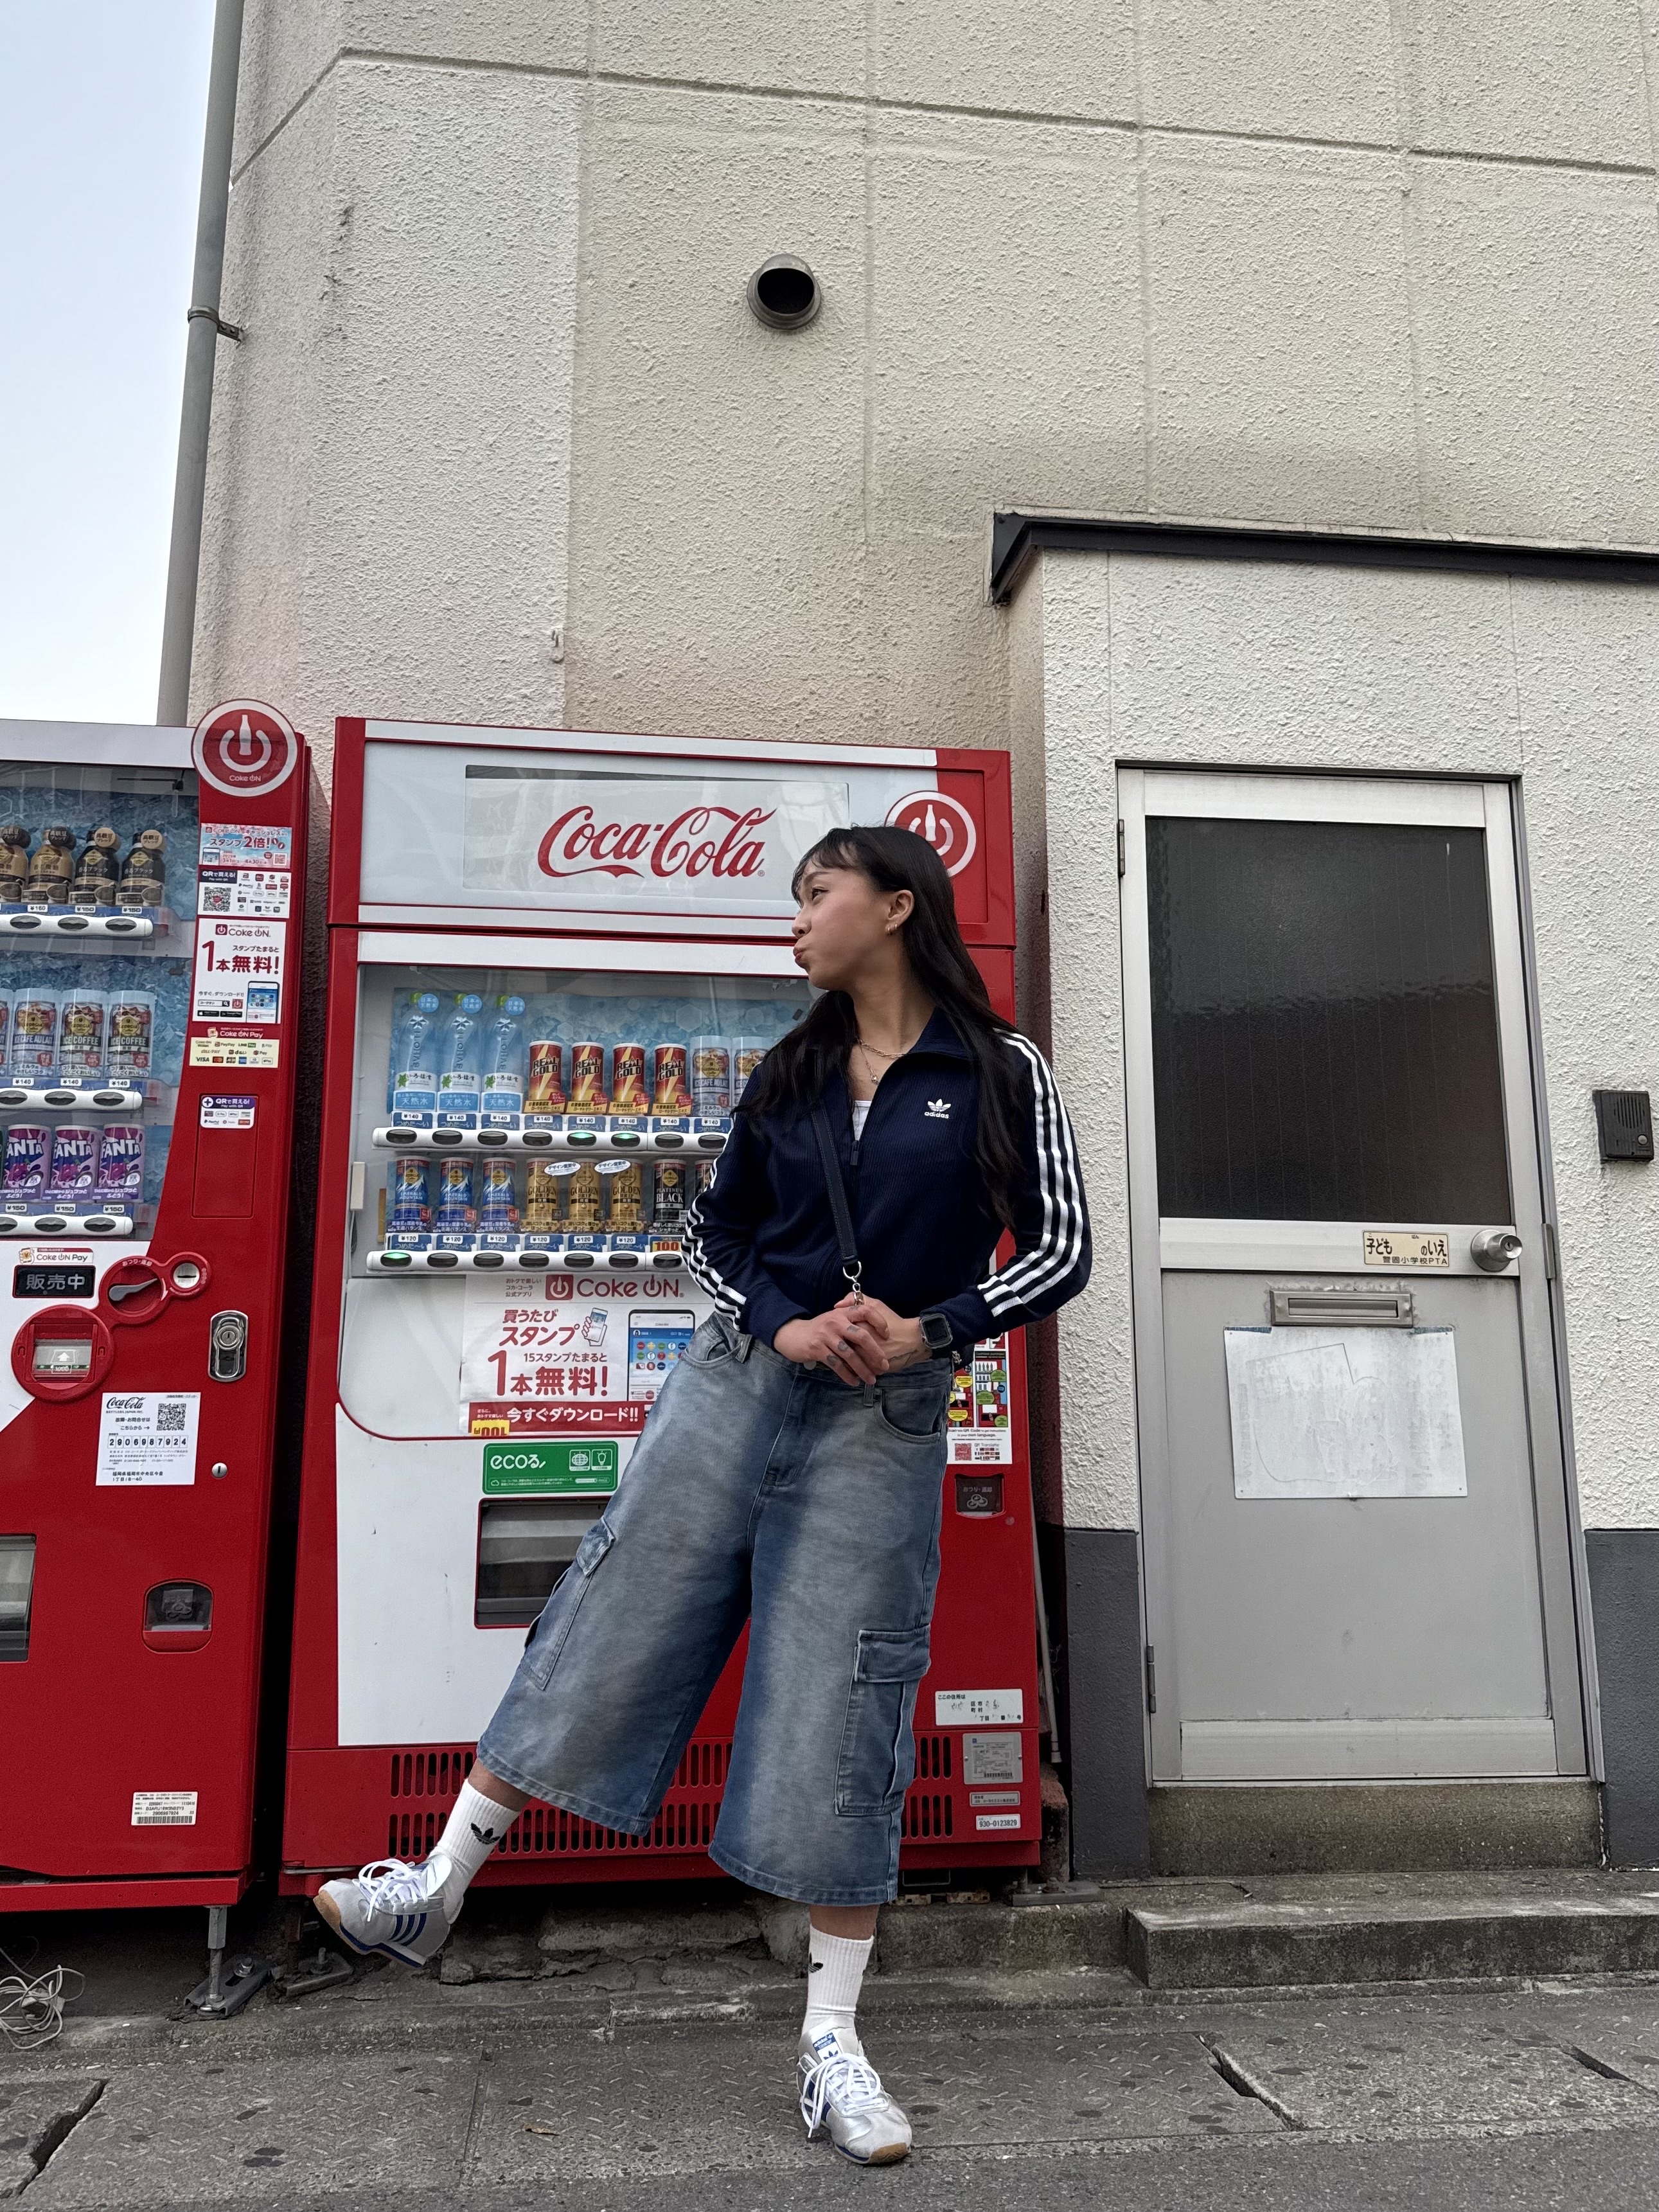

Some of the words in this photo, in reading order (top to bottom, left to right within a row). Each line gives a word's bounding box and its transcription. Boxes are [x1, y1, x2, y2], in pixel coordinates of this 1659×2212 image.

[538, 805, 777, 879] Coca-Cola
[229, 928, 253, 937] Coke
[254, 927, 269, 937] ON
[73, 1037, 99, 1045] COFFEE
[121, 1037, 146, 1046] COFFEE
[533, 1054, 558, 1068] REAL
[576, 1055, 599, 1069] REAL
[617, 1056, 641, 1070] REAL
[659, 1057, 683, 1071] REAL
[533, 1064, 558, 1077] GOLD
[575, 1066, 599, 1078] GOLD
[617, 1067, 641, 1080] GOLD
[659, 1068, 683, 1081] GOLD
[402, 1097, 429, 1105] 天然水
[446, 1098, 472, 1106] 天然水
[490, 1098, 514, 1107] 天然水
[6, 1139, 43, 1158] ANTA
[102, 1139, 140, 1158] FANTA
[528, 1186, 556, 1195] GOLDEN
[571, 1186, 599, 1195] GOLDEN
[613, 1186, 641, 1195] GOLDEN
[656, 1193, 683, 1203] BLACK
[654, 1242, 679, 1251] 100
[1366, 1238, 1392, 1254] 子ども
[1421, 1239, 1447, 1256] のいえ
[1383, 1256, 1448, 1265] 警固小学校PTA
[26, 1274, 85, 1290] 販売中
[577, 1278, 637, 1298] Coke
[643, 1274, 679, 1298] ON
[502, 1309, 558, 1323] 買うたび
[499, 1324, 580, 1346] スタンプ
[524, 1352, 607, 1362] 15スタンプたまると
[107, 1397, 146, 1409] Coca-Cola
